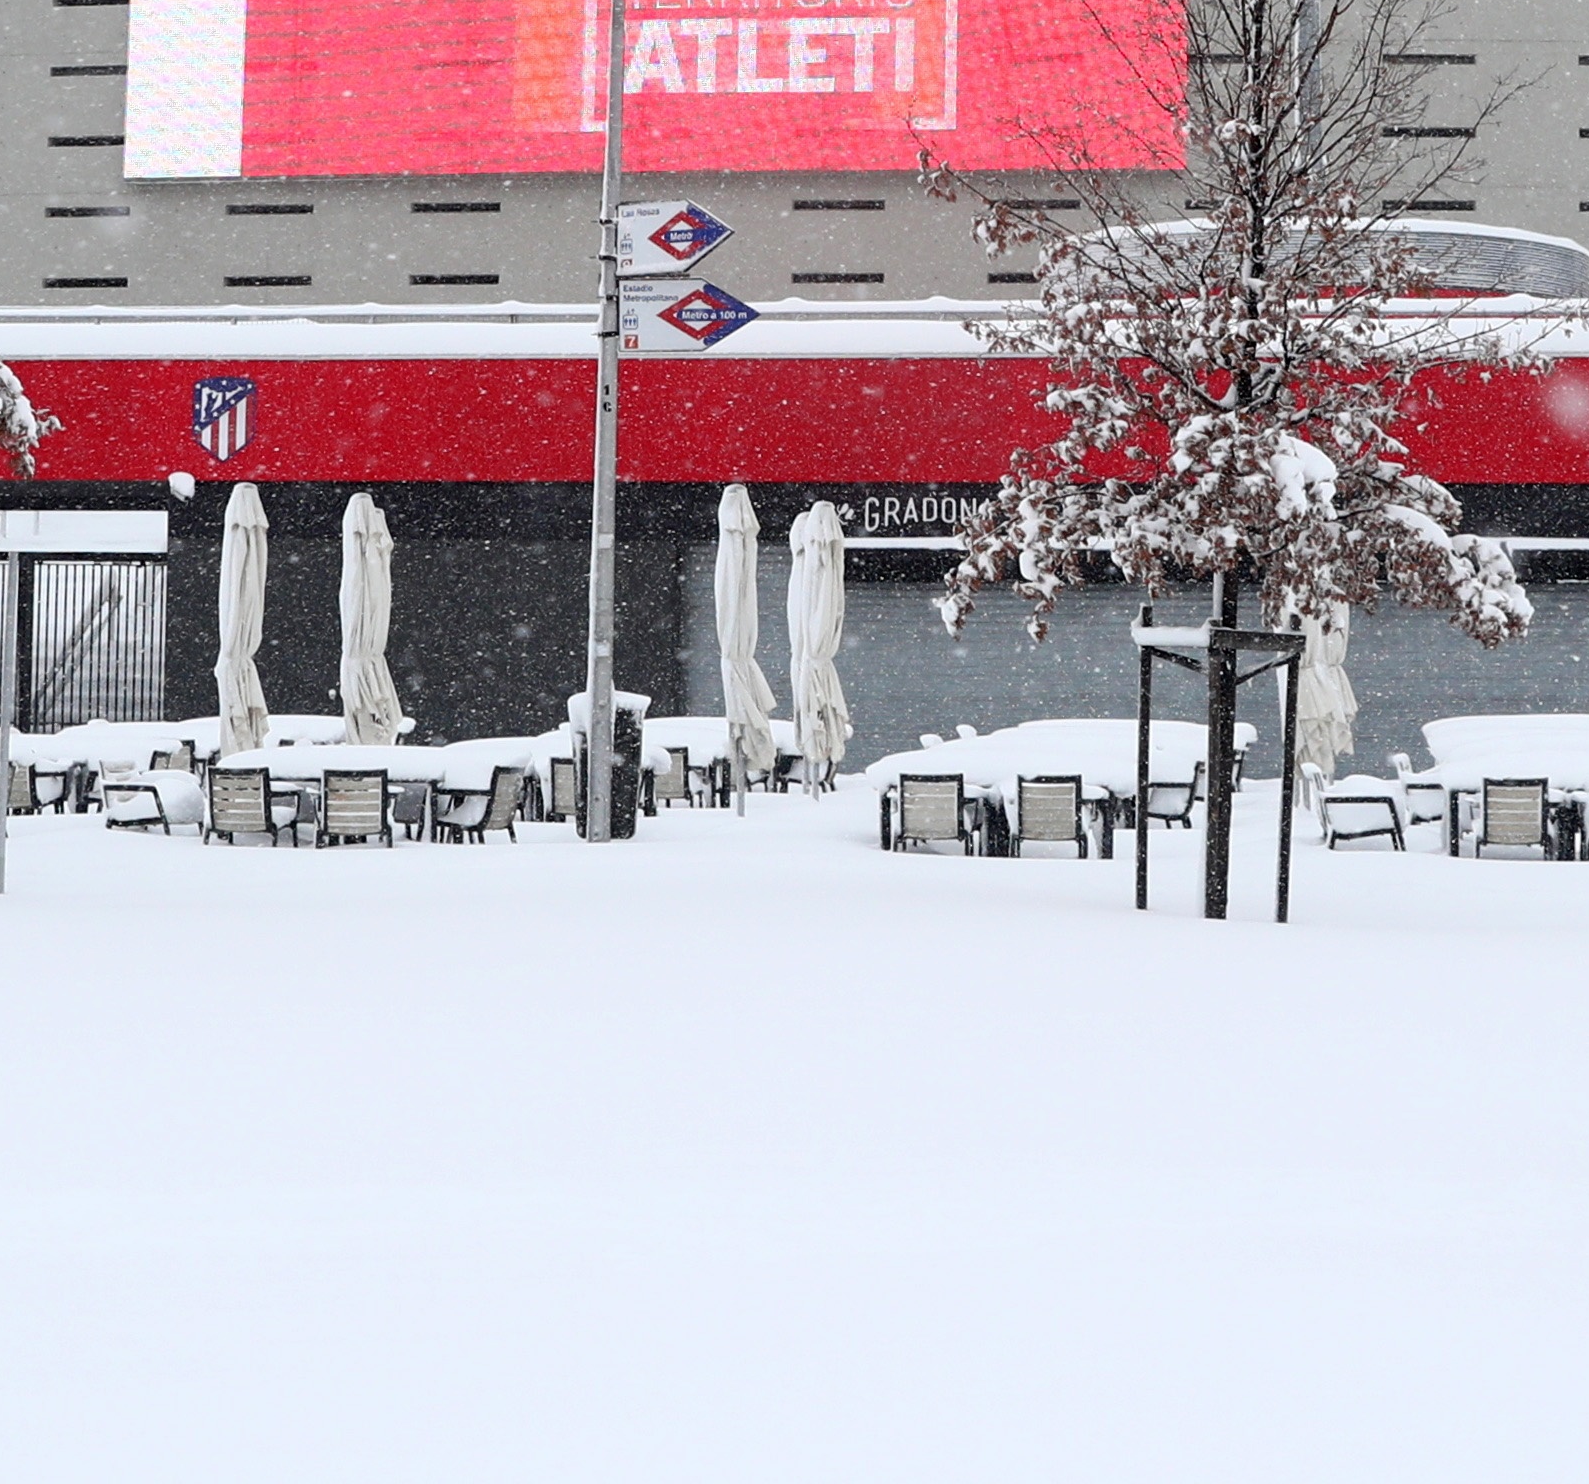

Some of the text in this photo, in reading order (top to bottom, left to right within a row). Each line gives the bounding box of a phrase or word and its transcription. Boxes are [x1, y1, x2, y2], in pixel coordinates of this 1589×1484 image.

[623, 17, 915, 94] ATLETI
[669, 231, 694, 241] Metro
[622, 284, 654, 293] Estadio
[622, 294, 680, 303] Metropolitano
[681, 311, 709, 320] Metro
[719, 311, 737, 320] 100
[738, 312, 748, 320] m
[864, 497, 994, 532] GRADON
